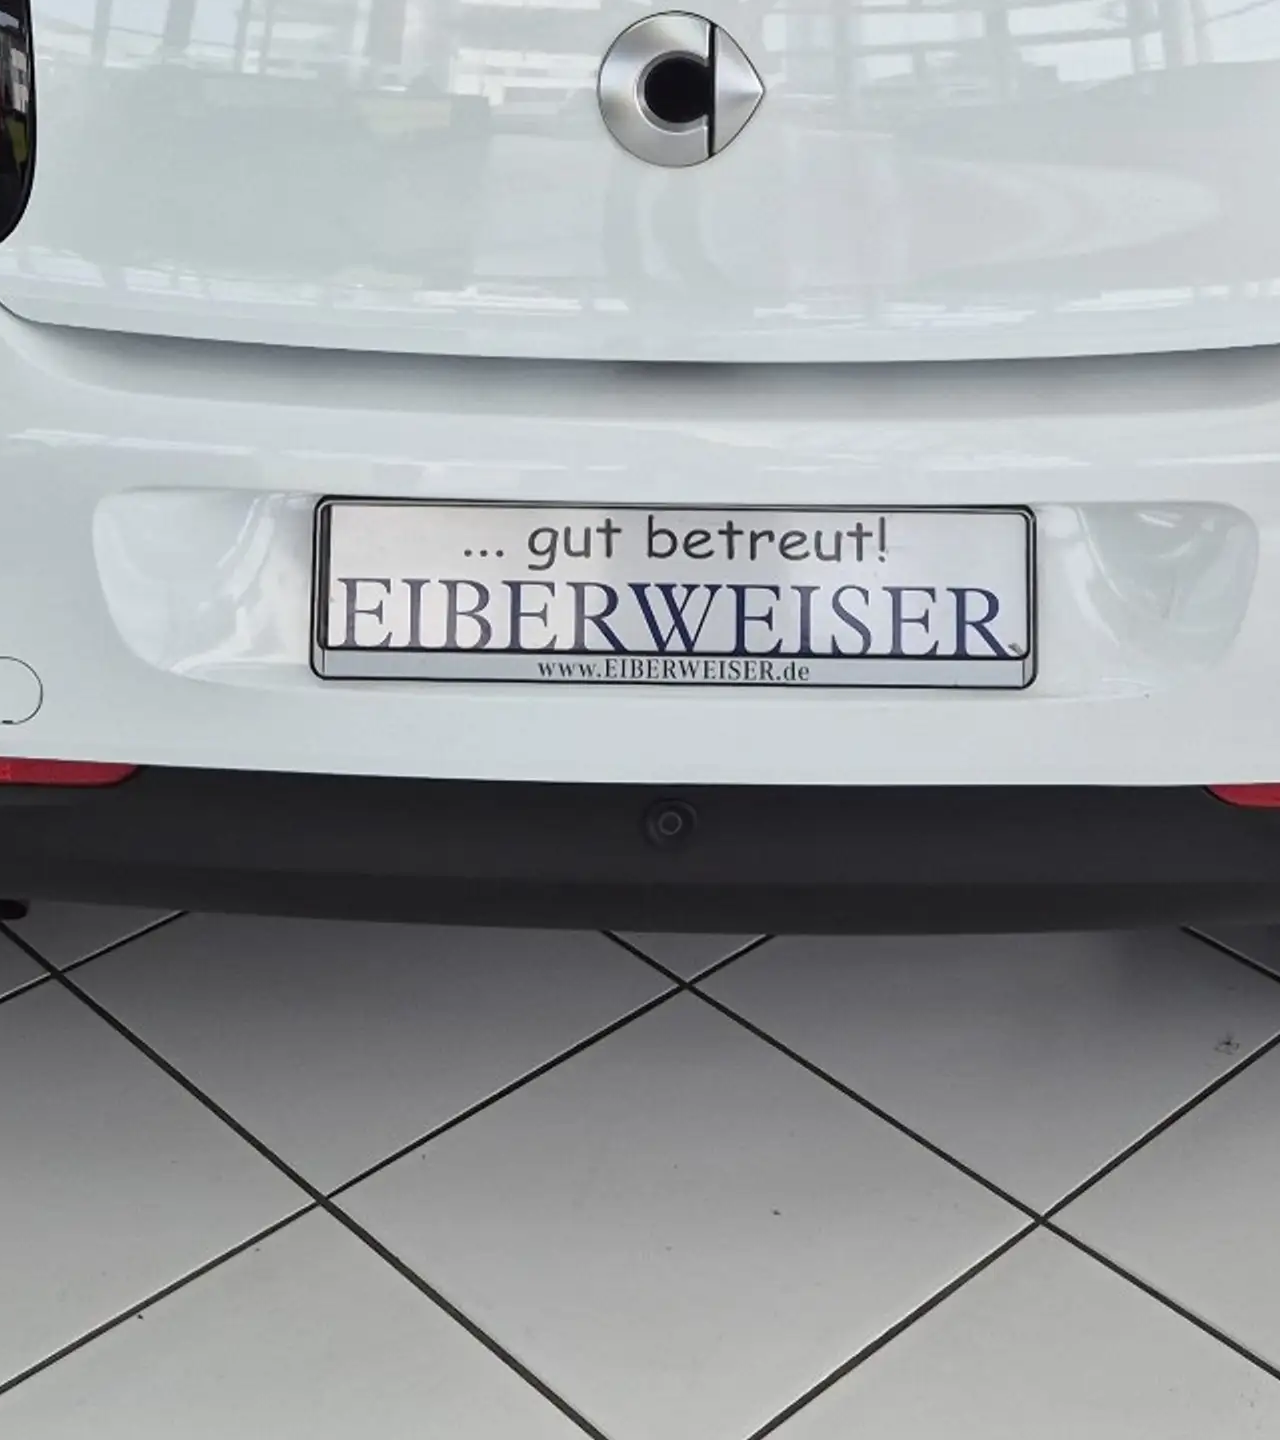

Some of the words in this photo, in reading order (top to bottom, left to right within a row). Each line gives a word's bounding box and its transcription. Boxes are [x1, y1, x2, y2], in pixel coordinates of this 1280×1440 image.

[527, 517, 622, 572] gut
[647, 514, 888, 563] betreut!
[337, 577, 1014, 657] EIBERWEISER
[537, 657, 810, 682] www.EIBERWEISER.de
